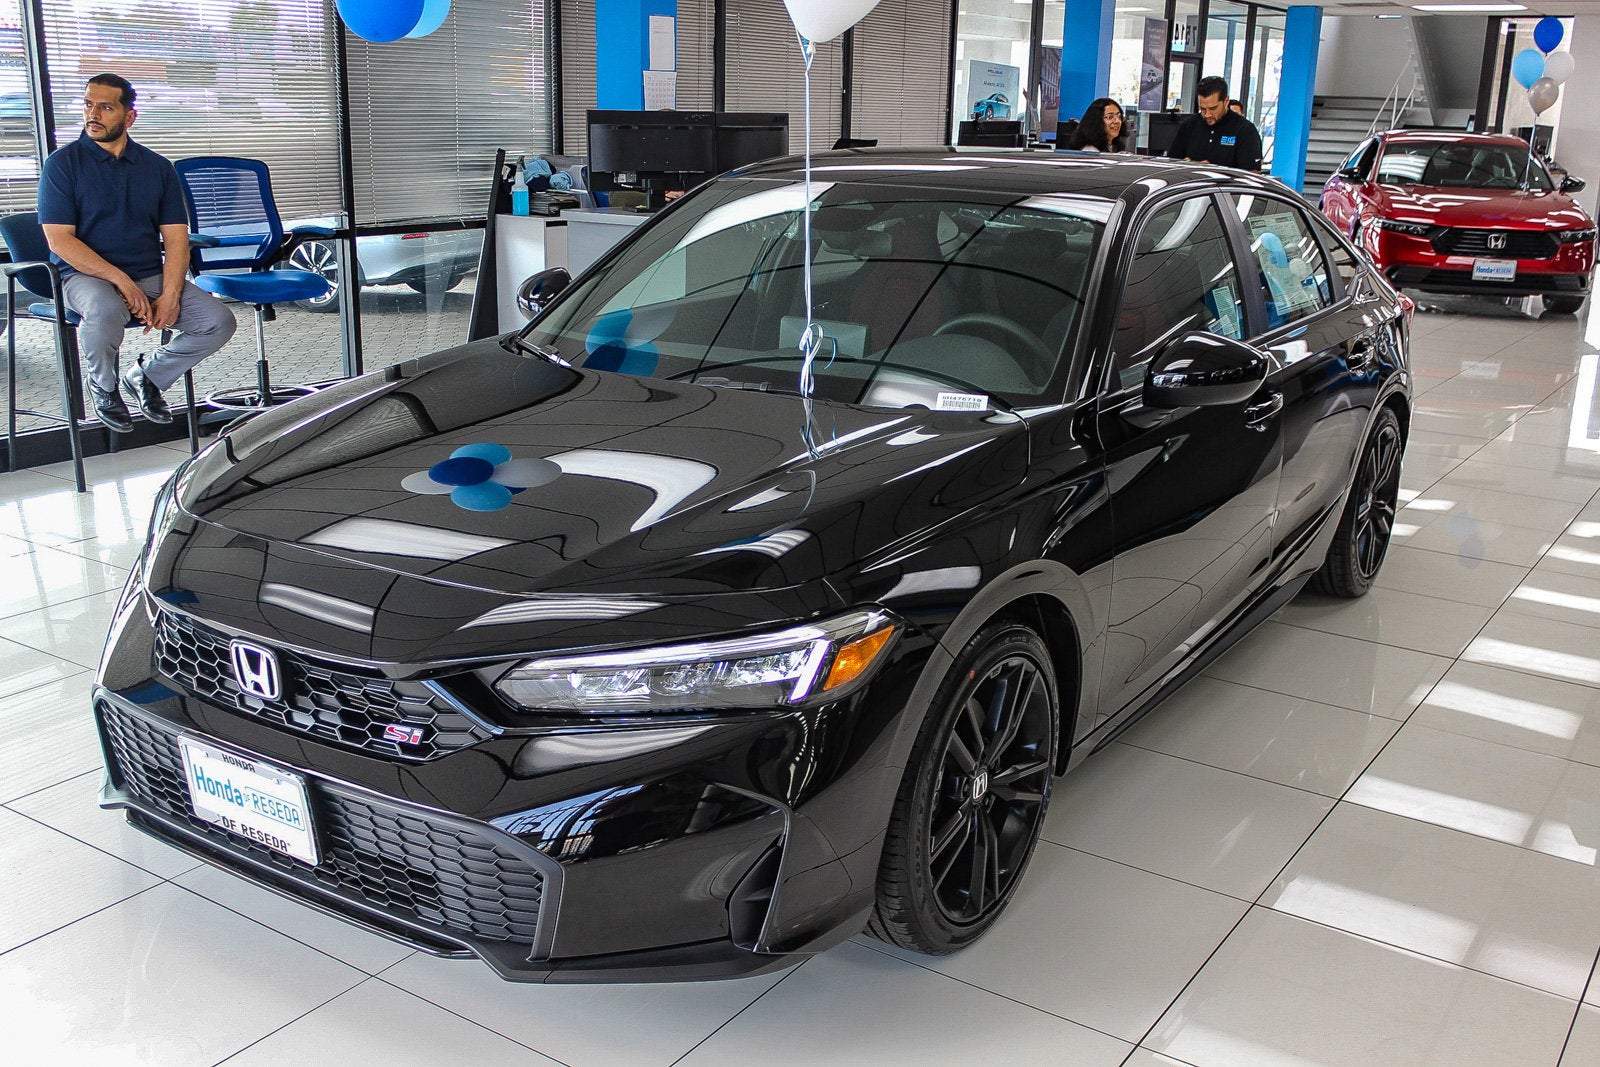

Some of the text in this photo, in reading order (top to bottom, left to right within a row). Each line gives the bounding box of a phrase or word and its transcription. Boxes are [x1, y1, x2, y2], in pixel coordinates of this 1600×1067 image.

[383, 724, 424, 745] Si
[221, 753, 256, 773] HONDA
[193, 764, 245, 807] Honda
[252, 792, 301, 826] RESEDA
[221, 815, 289, 852] OF RESEDA
